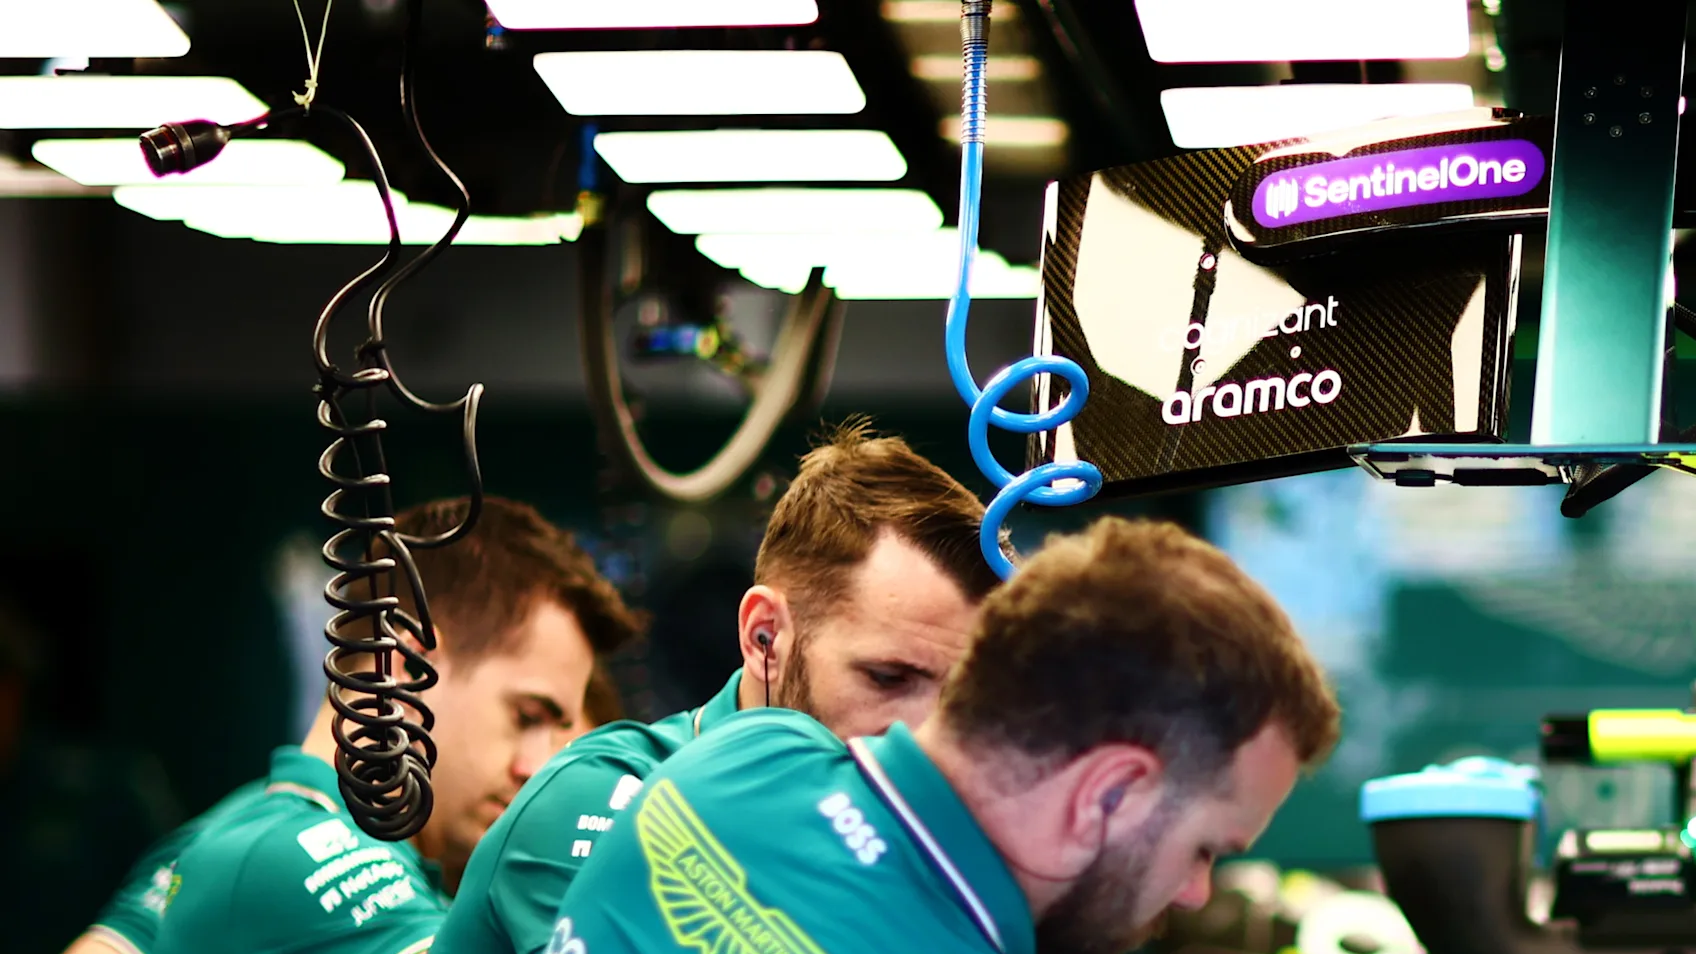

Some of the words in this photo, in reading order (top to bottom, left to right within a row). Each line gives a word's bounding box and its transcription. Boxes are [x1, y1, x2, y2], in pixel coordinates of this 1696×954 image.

[1303, 153, 1527, 208] SentinelOne
[1161, 369, 1342, 425] aramco
[816, 791, 887, 865] BOSS
[677, 853, 738, 912] ASTON
